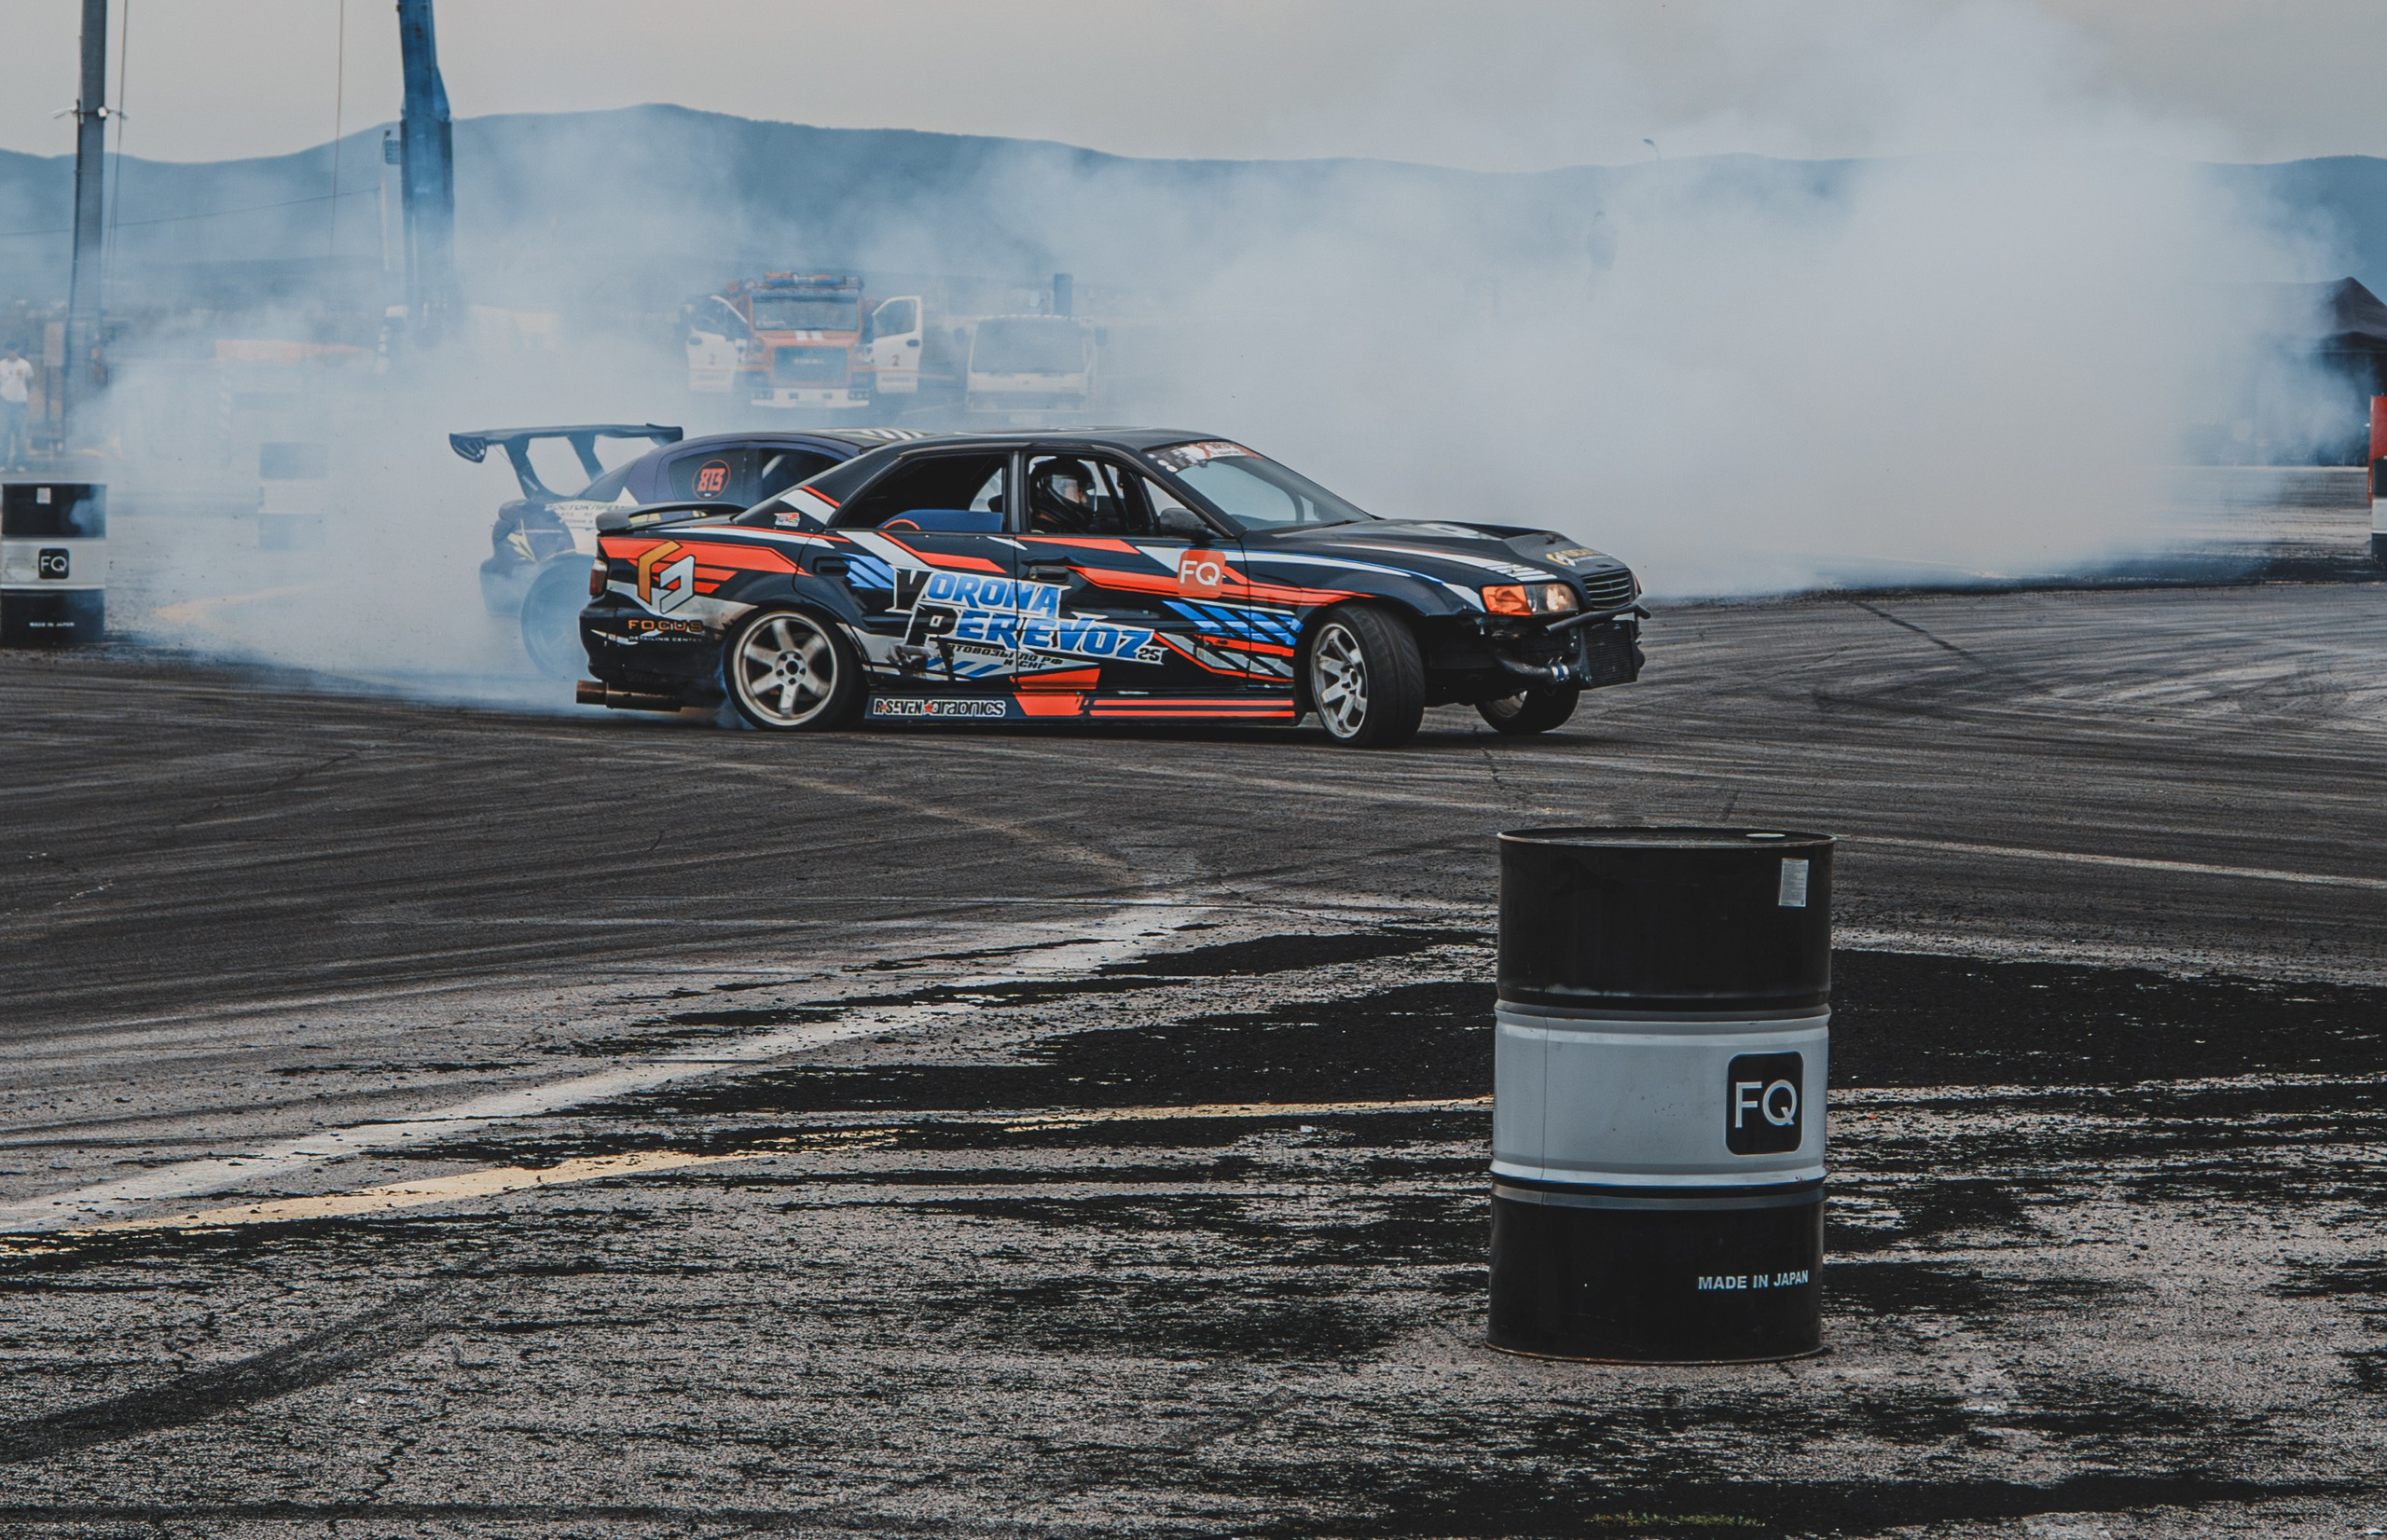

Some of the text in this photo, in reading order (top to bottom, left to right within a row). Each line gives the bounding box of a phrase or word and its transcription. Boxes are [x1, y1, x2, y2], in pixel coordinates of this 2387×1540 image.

[697, 468, 725, 491] 813
[41, 556, 67, 571] FQ
[1180, 560, 1221, 586] FQ
[892, 567, 1061, 618] VORONA
[628, 619, 704, 632] FOCUS
[906, 605, 1153, 660] PEREVOZ
[1018, 660, 1046, 669] СНГ
[1041, 655, 1064, 666] РФ
[1735, 1079, 1797, 1128] FQ
[1698, 1270, 1809, 1290] MADE IN JAPAN
